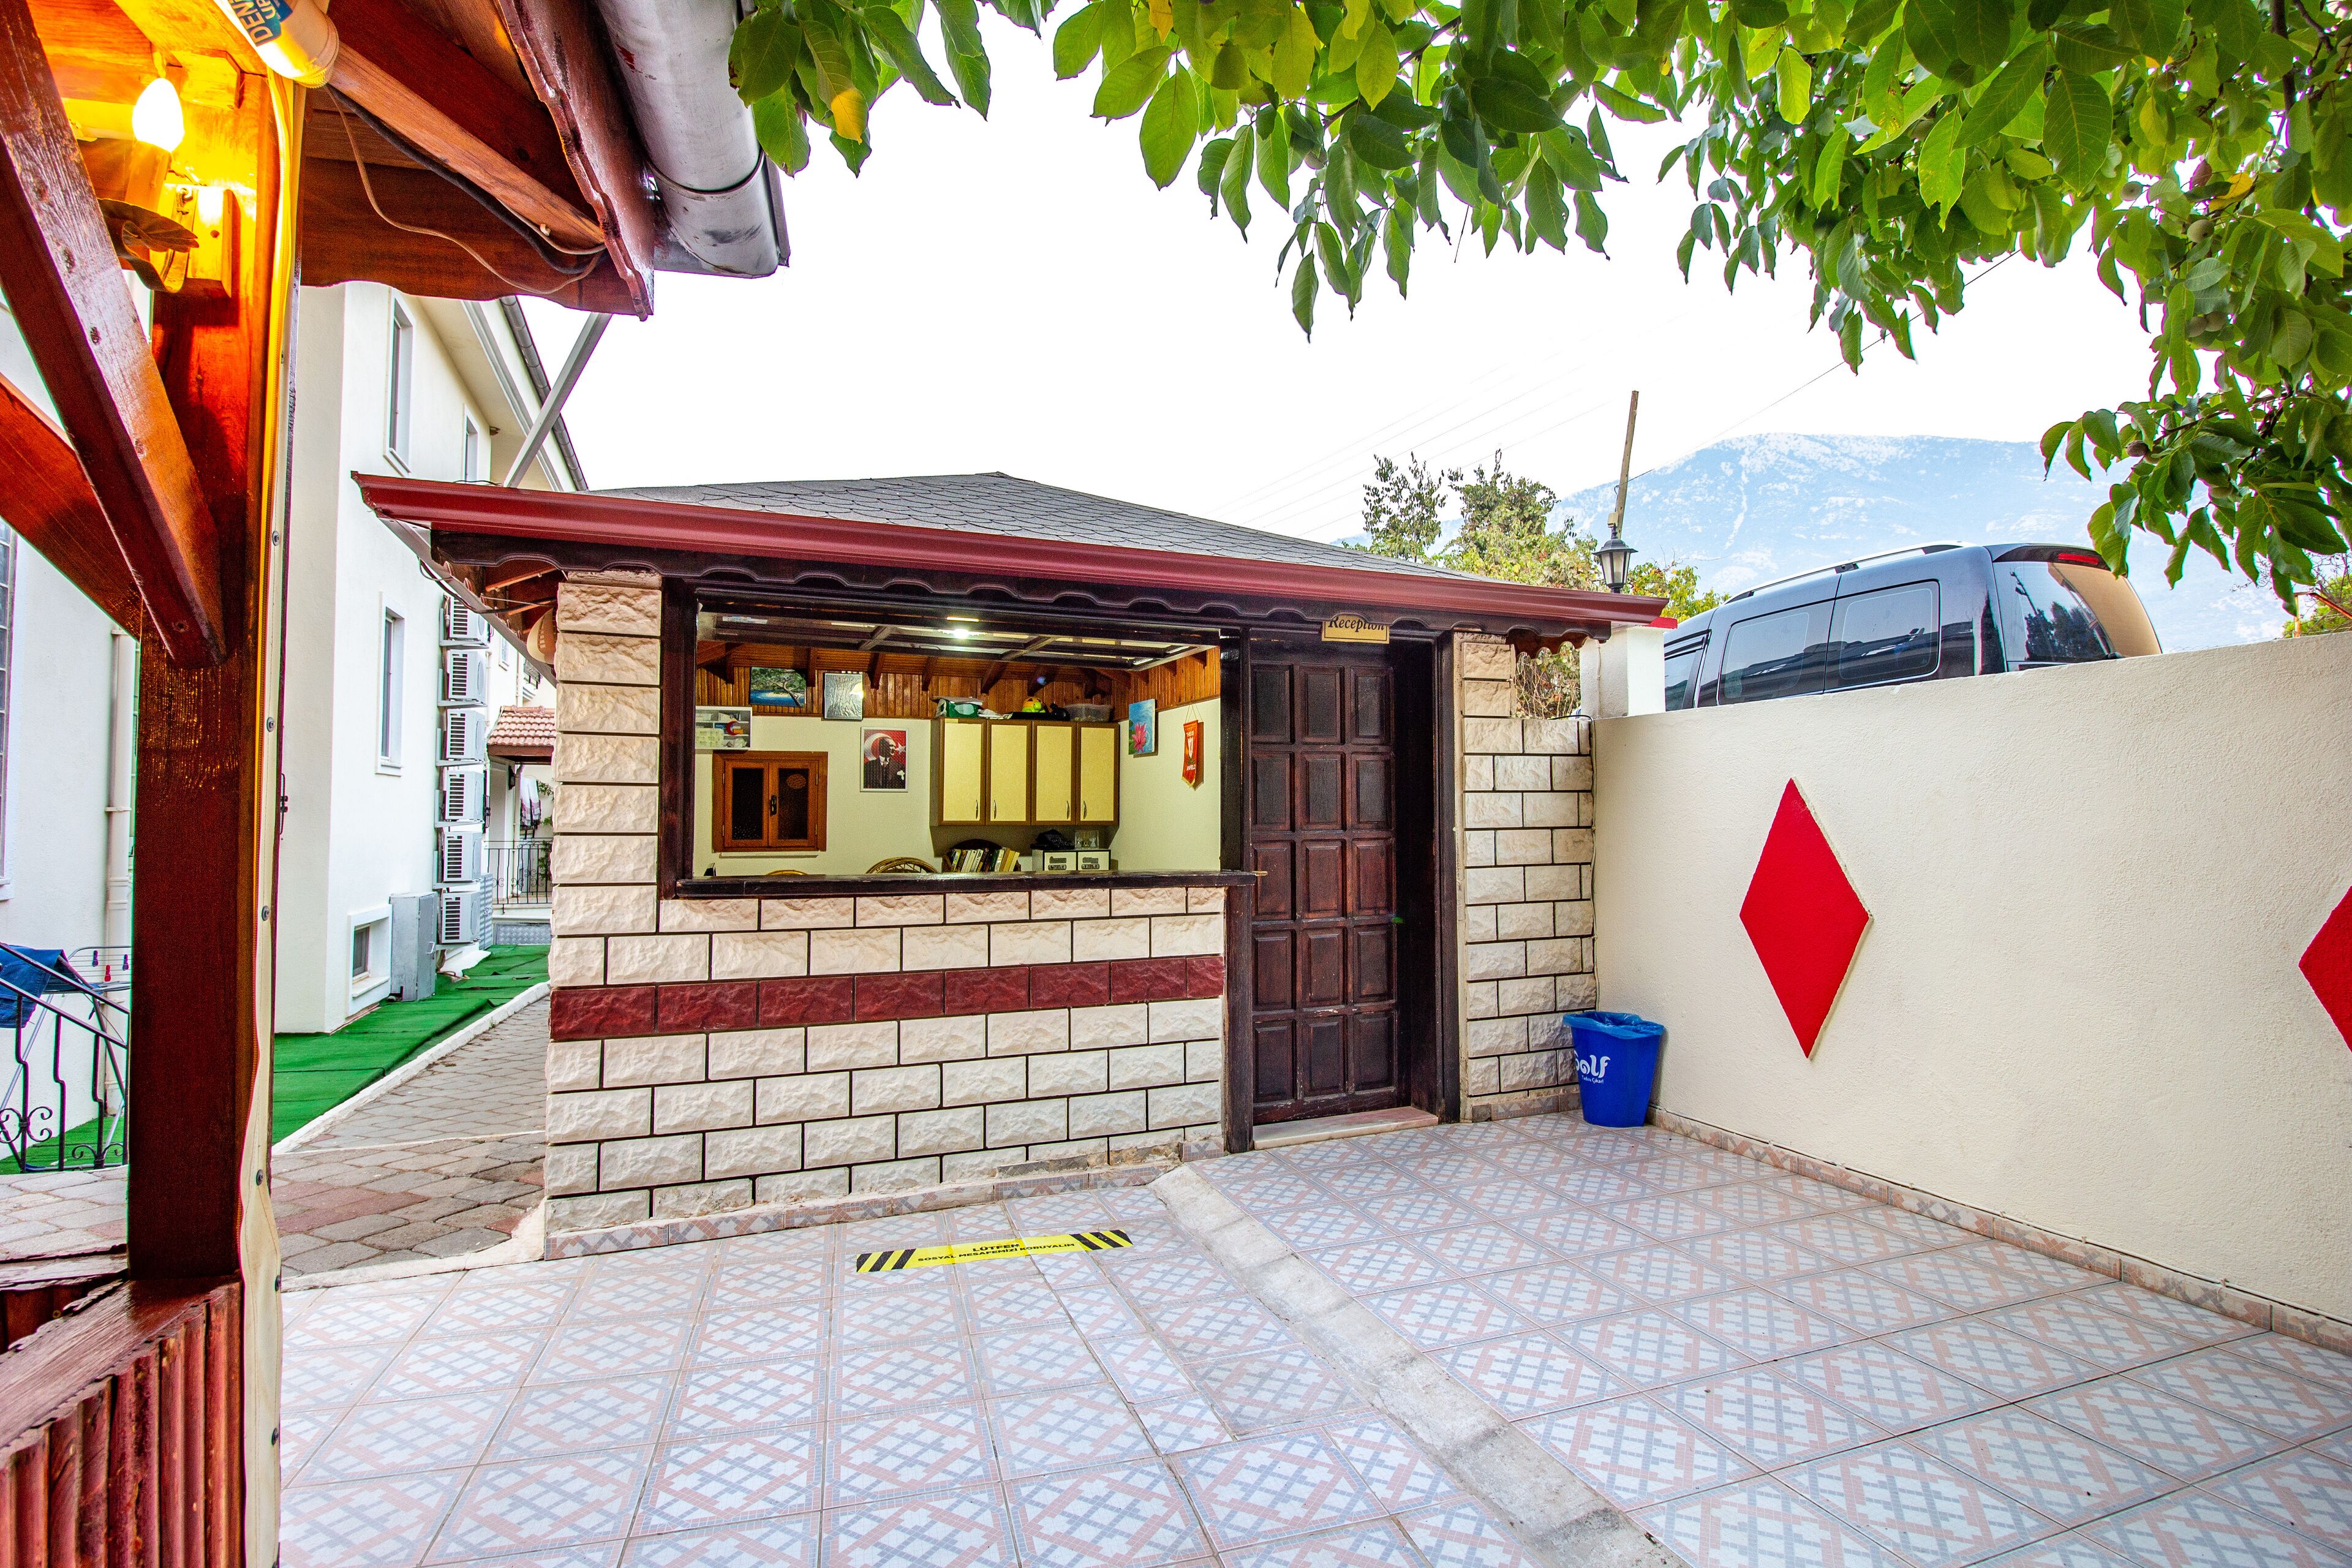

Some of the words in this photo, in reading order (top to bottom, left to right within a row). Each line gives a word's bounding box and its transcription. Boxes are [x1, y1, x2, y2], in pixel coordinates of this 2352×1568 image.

[1328, 616, 1384, 633] Reception
[973, 1243, 1020, 1252] LÜTFEN
[959, 1248, 1018, 1257] MESAFEMİZİ
